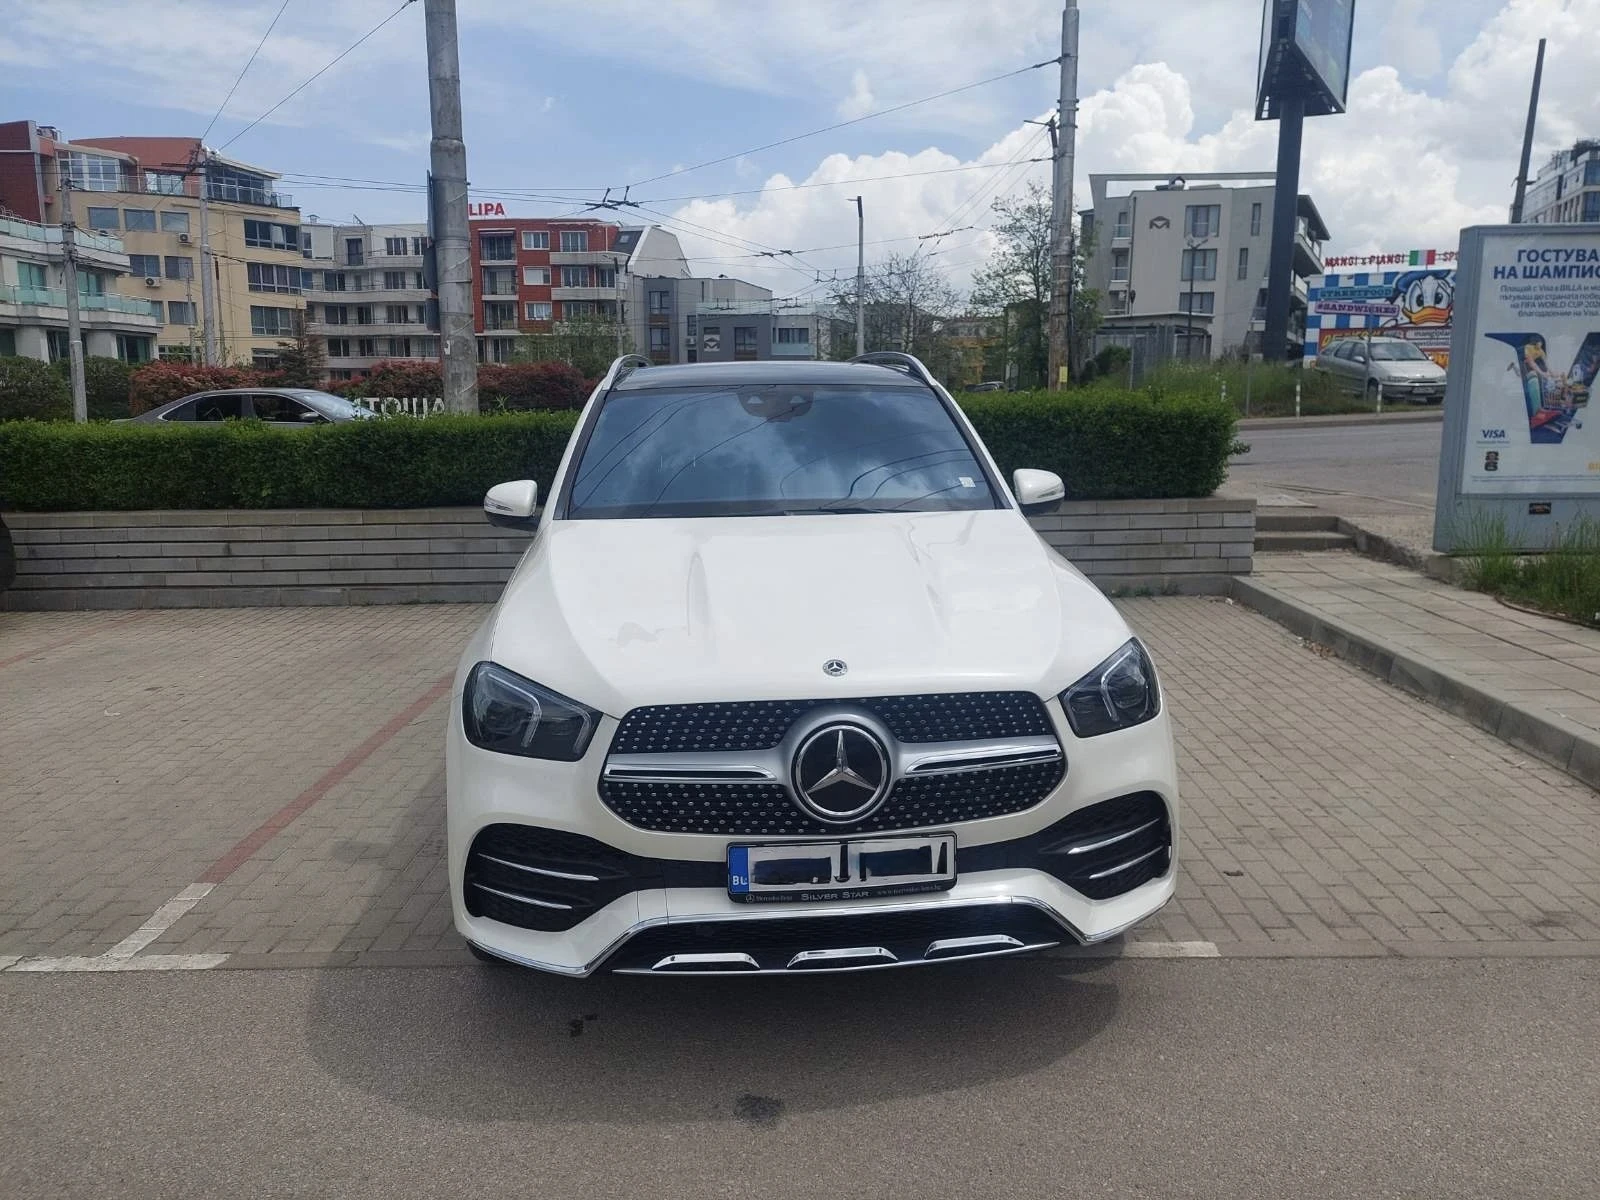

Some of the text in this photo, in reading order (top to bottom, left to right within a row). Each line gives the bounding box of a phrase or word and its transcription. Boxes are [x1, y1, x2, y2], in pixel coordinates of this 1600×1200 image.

[468, 202, 505, 216] LIPA
[1443, 252, 1457, 261] SP
[1517, 249, 1600, 263] ГОСТУВА
[1493, 266, 1518, 280] НА
[1482, 429, 1506, 439] VISA
[801, 892, 839, 900] SILVER
[842, 890, 869, 899] STAR
